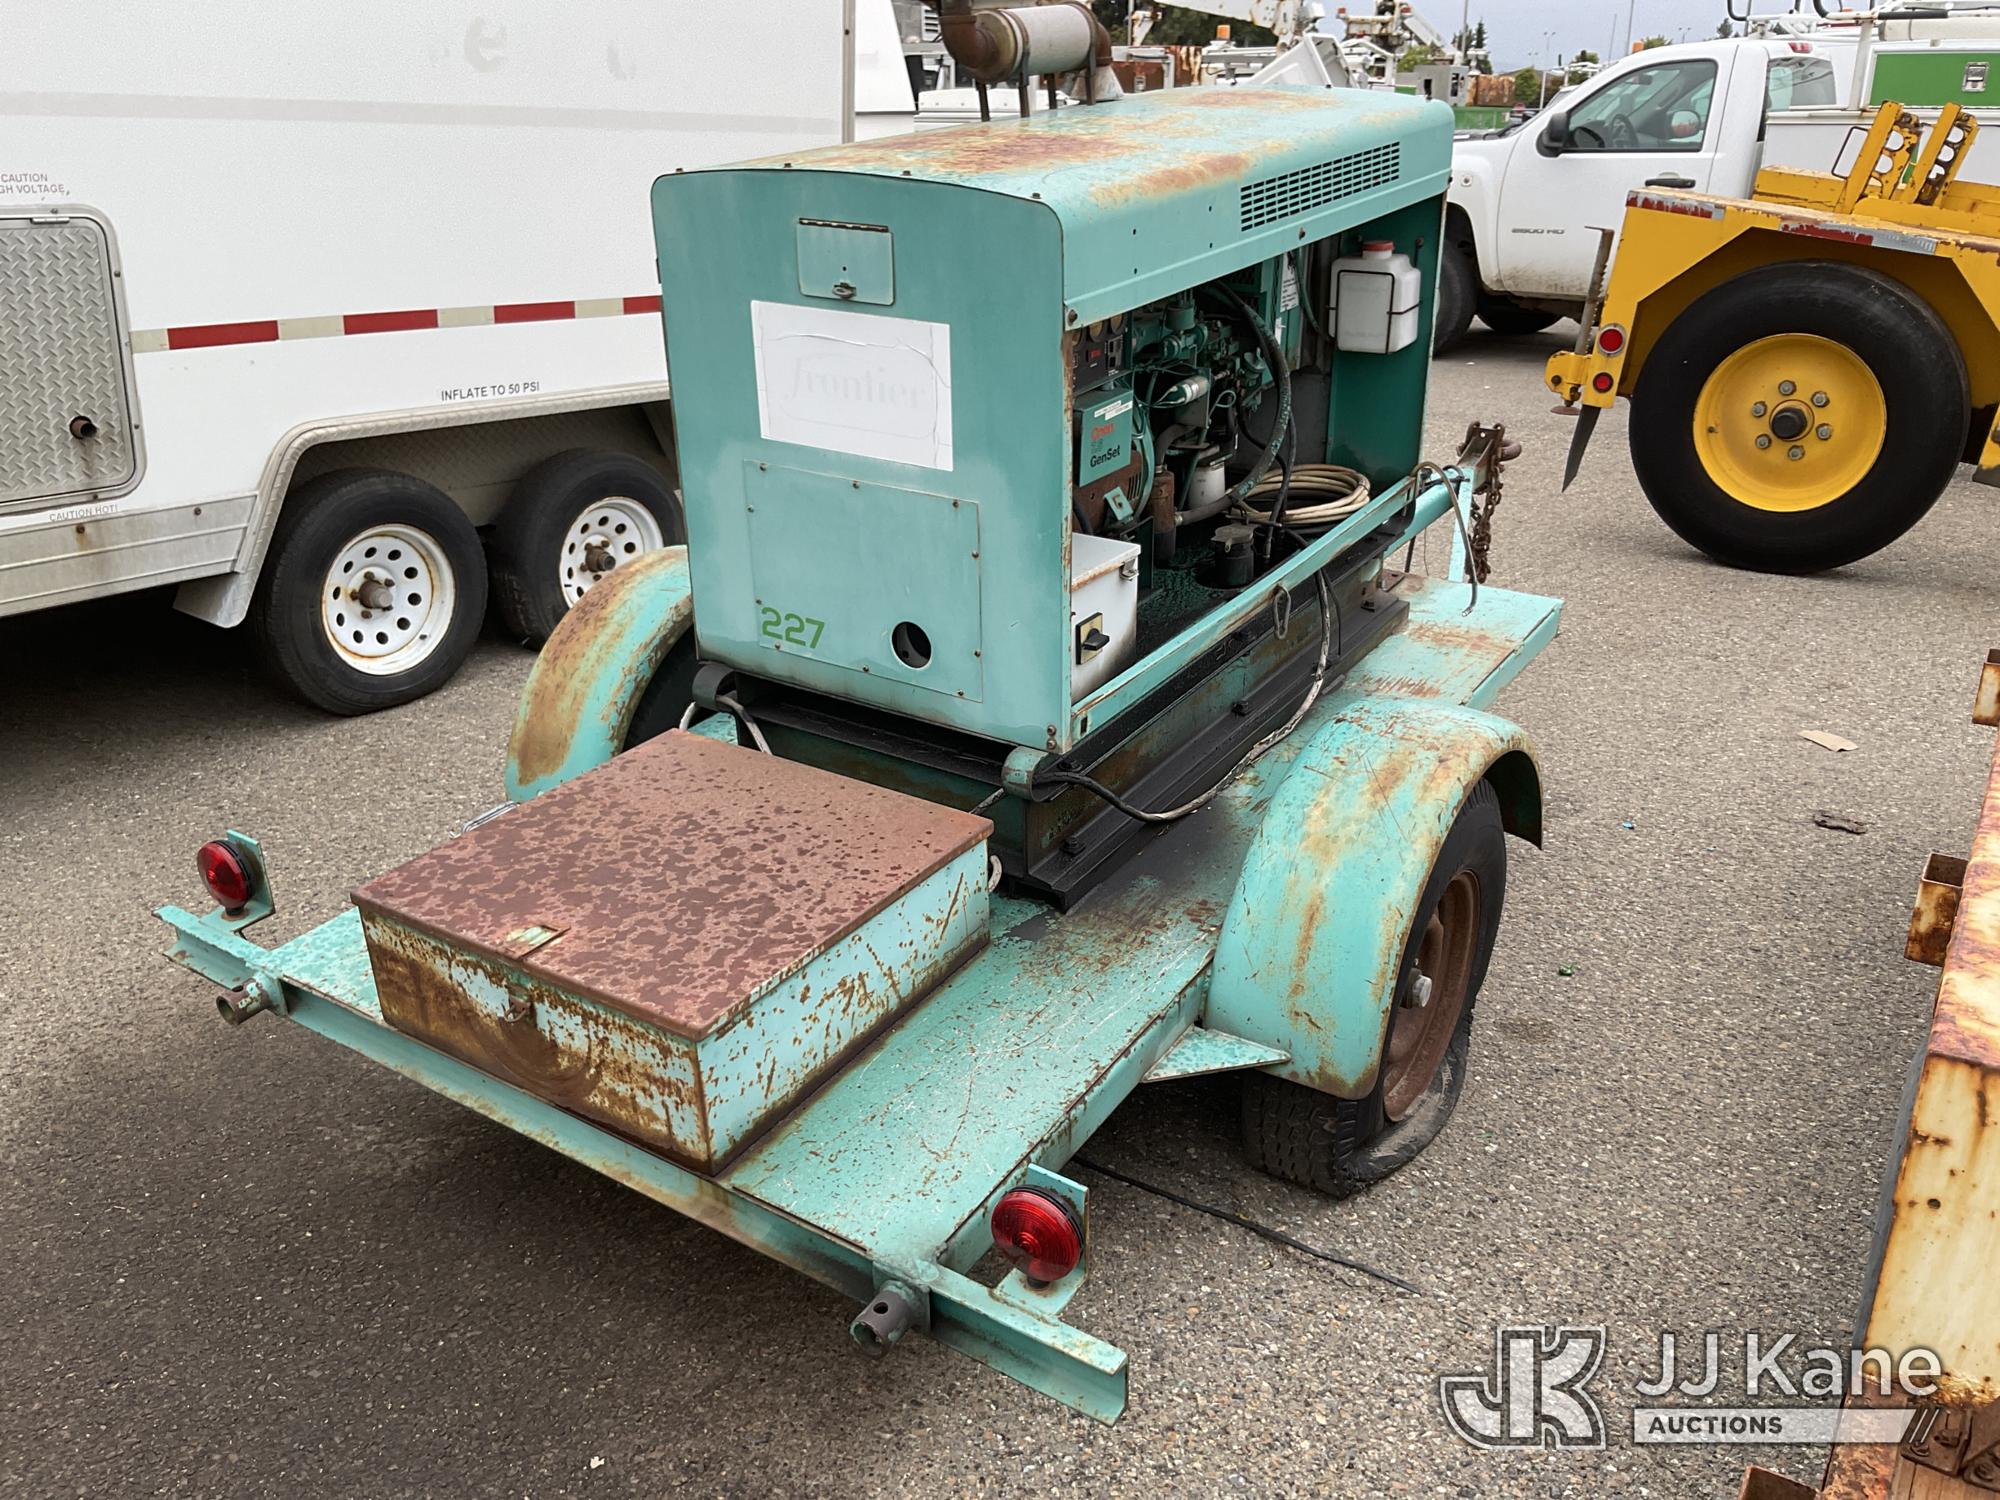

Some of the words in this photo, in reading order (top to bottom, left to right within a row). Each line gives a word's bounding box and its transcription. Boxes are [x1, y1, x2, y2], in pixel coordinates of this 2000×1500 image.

[0, 173, 48, 183] CAUTION
[16, 183, 65, 194] VOLTAGE
[441, 386, 488, 401] INFLATE
[490, 384, 506, 396] TO
[508, 383, 520, 395] 50
[522, 381, 540, 393] PSI
[1090, 444, 1121, 468] GenSet
[49, 507, 92, 522] CAUTION
[761, 606, 825, 649] 227
